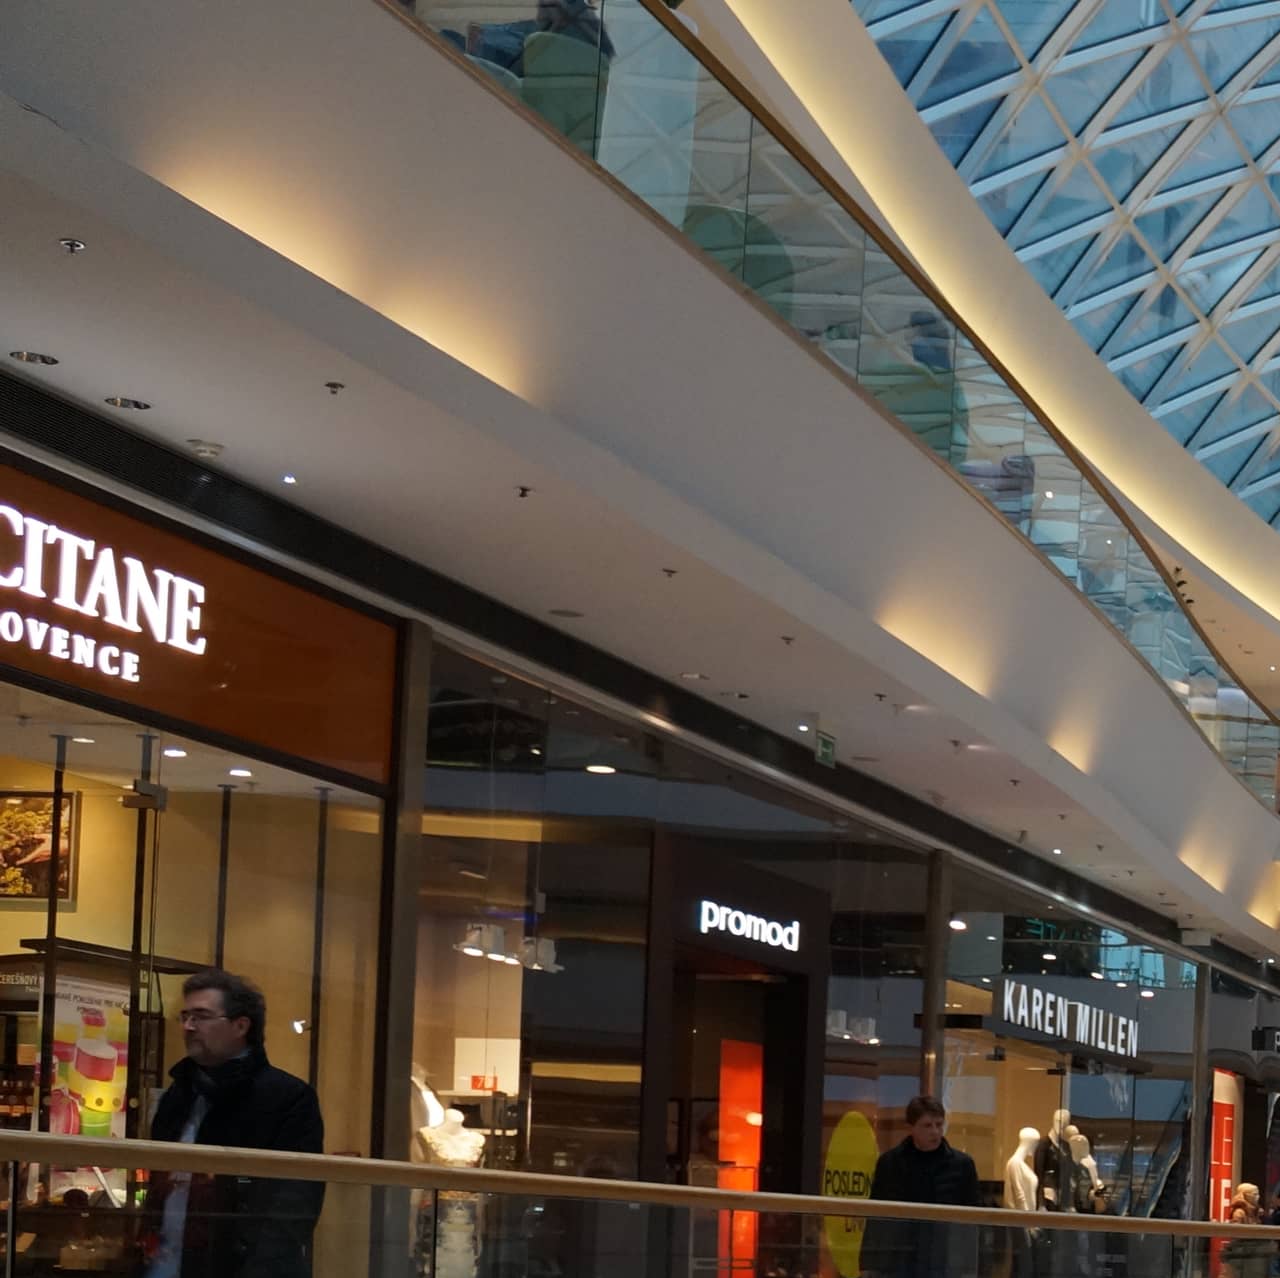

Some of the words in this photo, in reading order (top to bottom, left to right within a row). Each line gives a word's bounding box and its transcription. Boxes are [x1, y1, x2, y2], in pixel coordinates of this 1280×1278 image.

[0, 505, 206, 655] CITANE
[0, 611, 140, 682] OVENCE
[701, 900, 799, 952] promod
[1004, 979, 1069, 1039] KAREN
[1075, 1003, 1138, 1058] MILLEN
